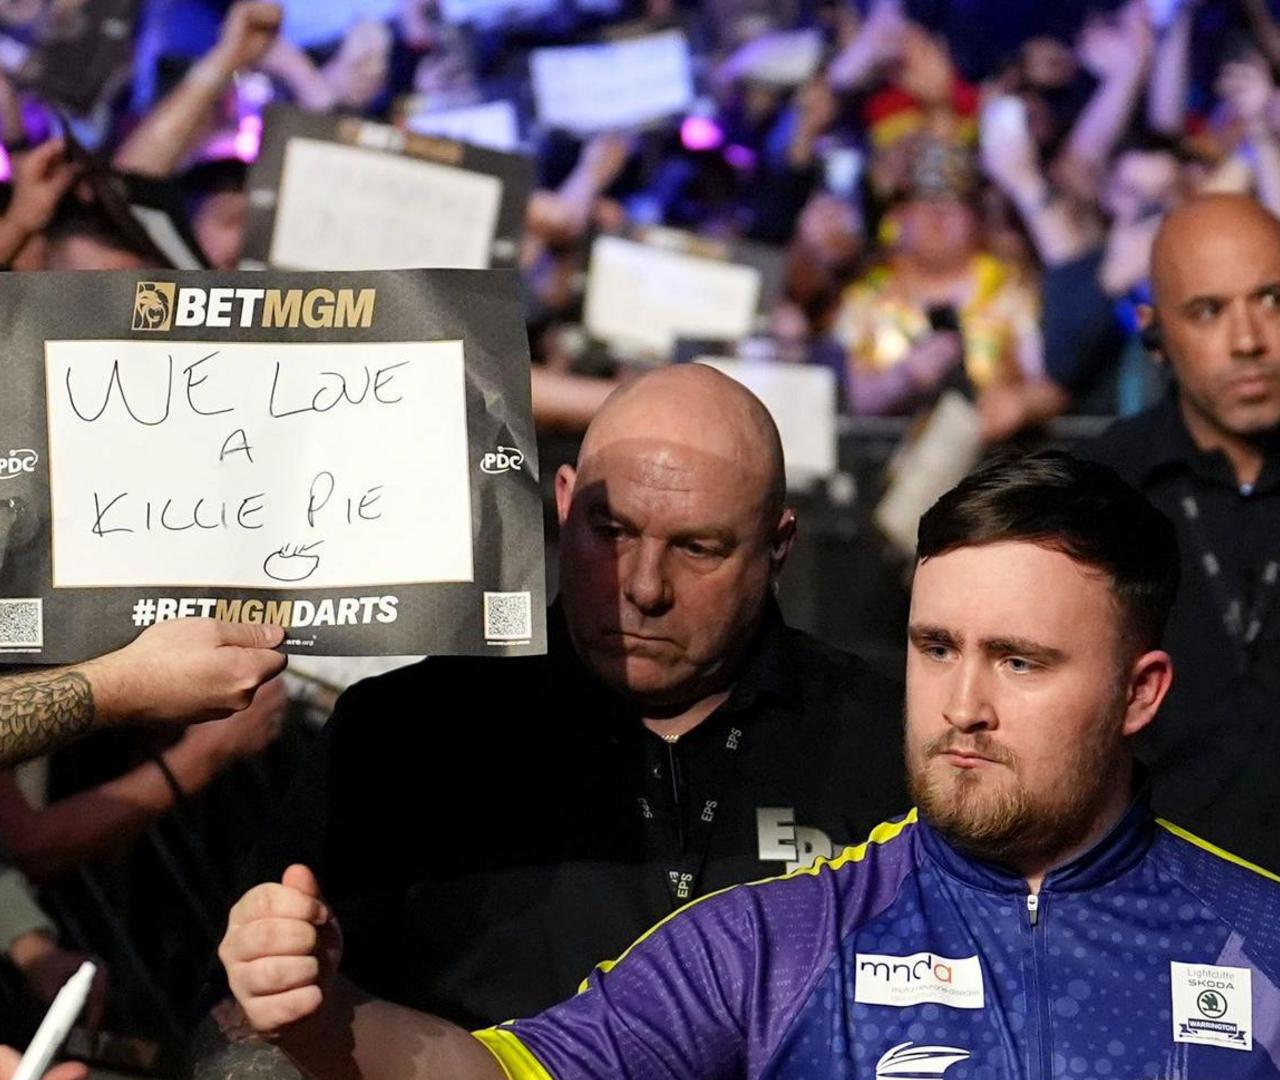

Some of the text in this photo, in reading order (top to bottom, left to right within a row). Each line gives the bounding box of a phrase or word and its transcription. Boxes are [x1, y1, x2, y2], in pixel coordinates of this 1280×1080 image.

[174, 287, 376, 329] BETMGM
[66, 351, 411, 426] WE LOVE
[219, 428, 254, 463] A
[483, 451, 523, 472] PDC
[90, 471, 385, 537] KILLIE PIE
[131, 595, 400, 628] #BETMGMDARTS
[725, 727, 743, 750] EPS
[700, 799, 718, 822] EPS
[756, 806, 844, 875] EP
[677, 872, 694, 898] EPS
[860, 954, 952, 984] mnda
[1189, 1020, 1237, 1032] WARRINGTON
